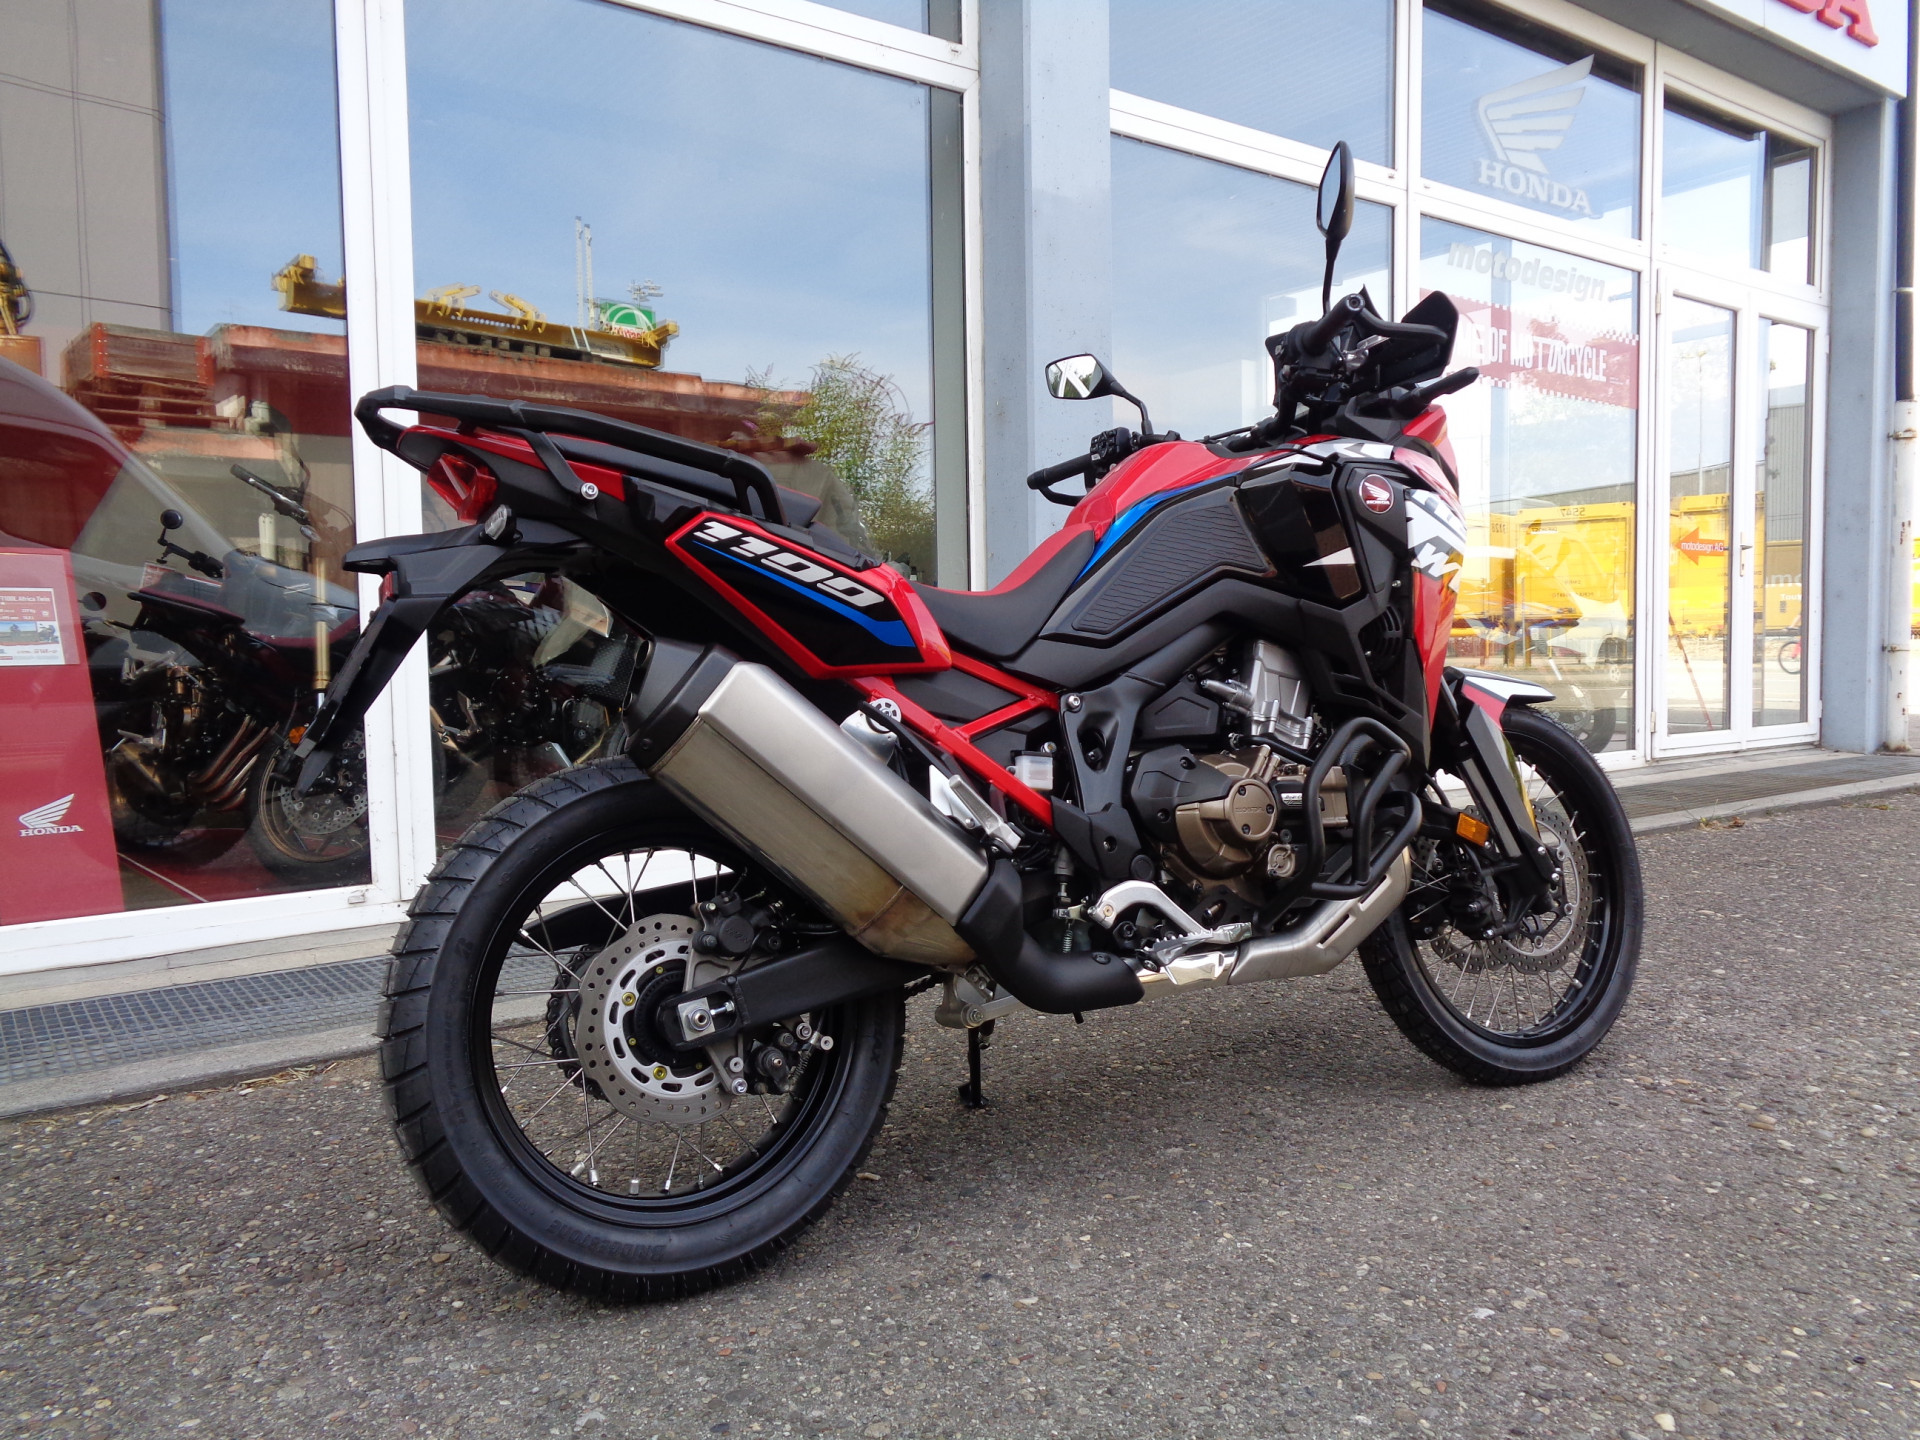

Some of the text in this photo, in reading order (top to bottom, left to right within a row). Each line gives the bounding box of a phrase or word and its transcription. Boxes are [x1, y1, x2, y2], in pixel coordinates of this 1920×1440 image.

[1478, 158, 1593, 215] HONDA
[1447, 242, 1606, 302] motodesign
[1489, 327, 1508, 363] OF
[1510, 332, 1608, 382] MOTORCYCLE
[693, 521, 885, 607] 1100
[1681, 541, 1713, 554] motodesign
[19, 825, 84, 837] HONDA
